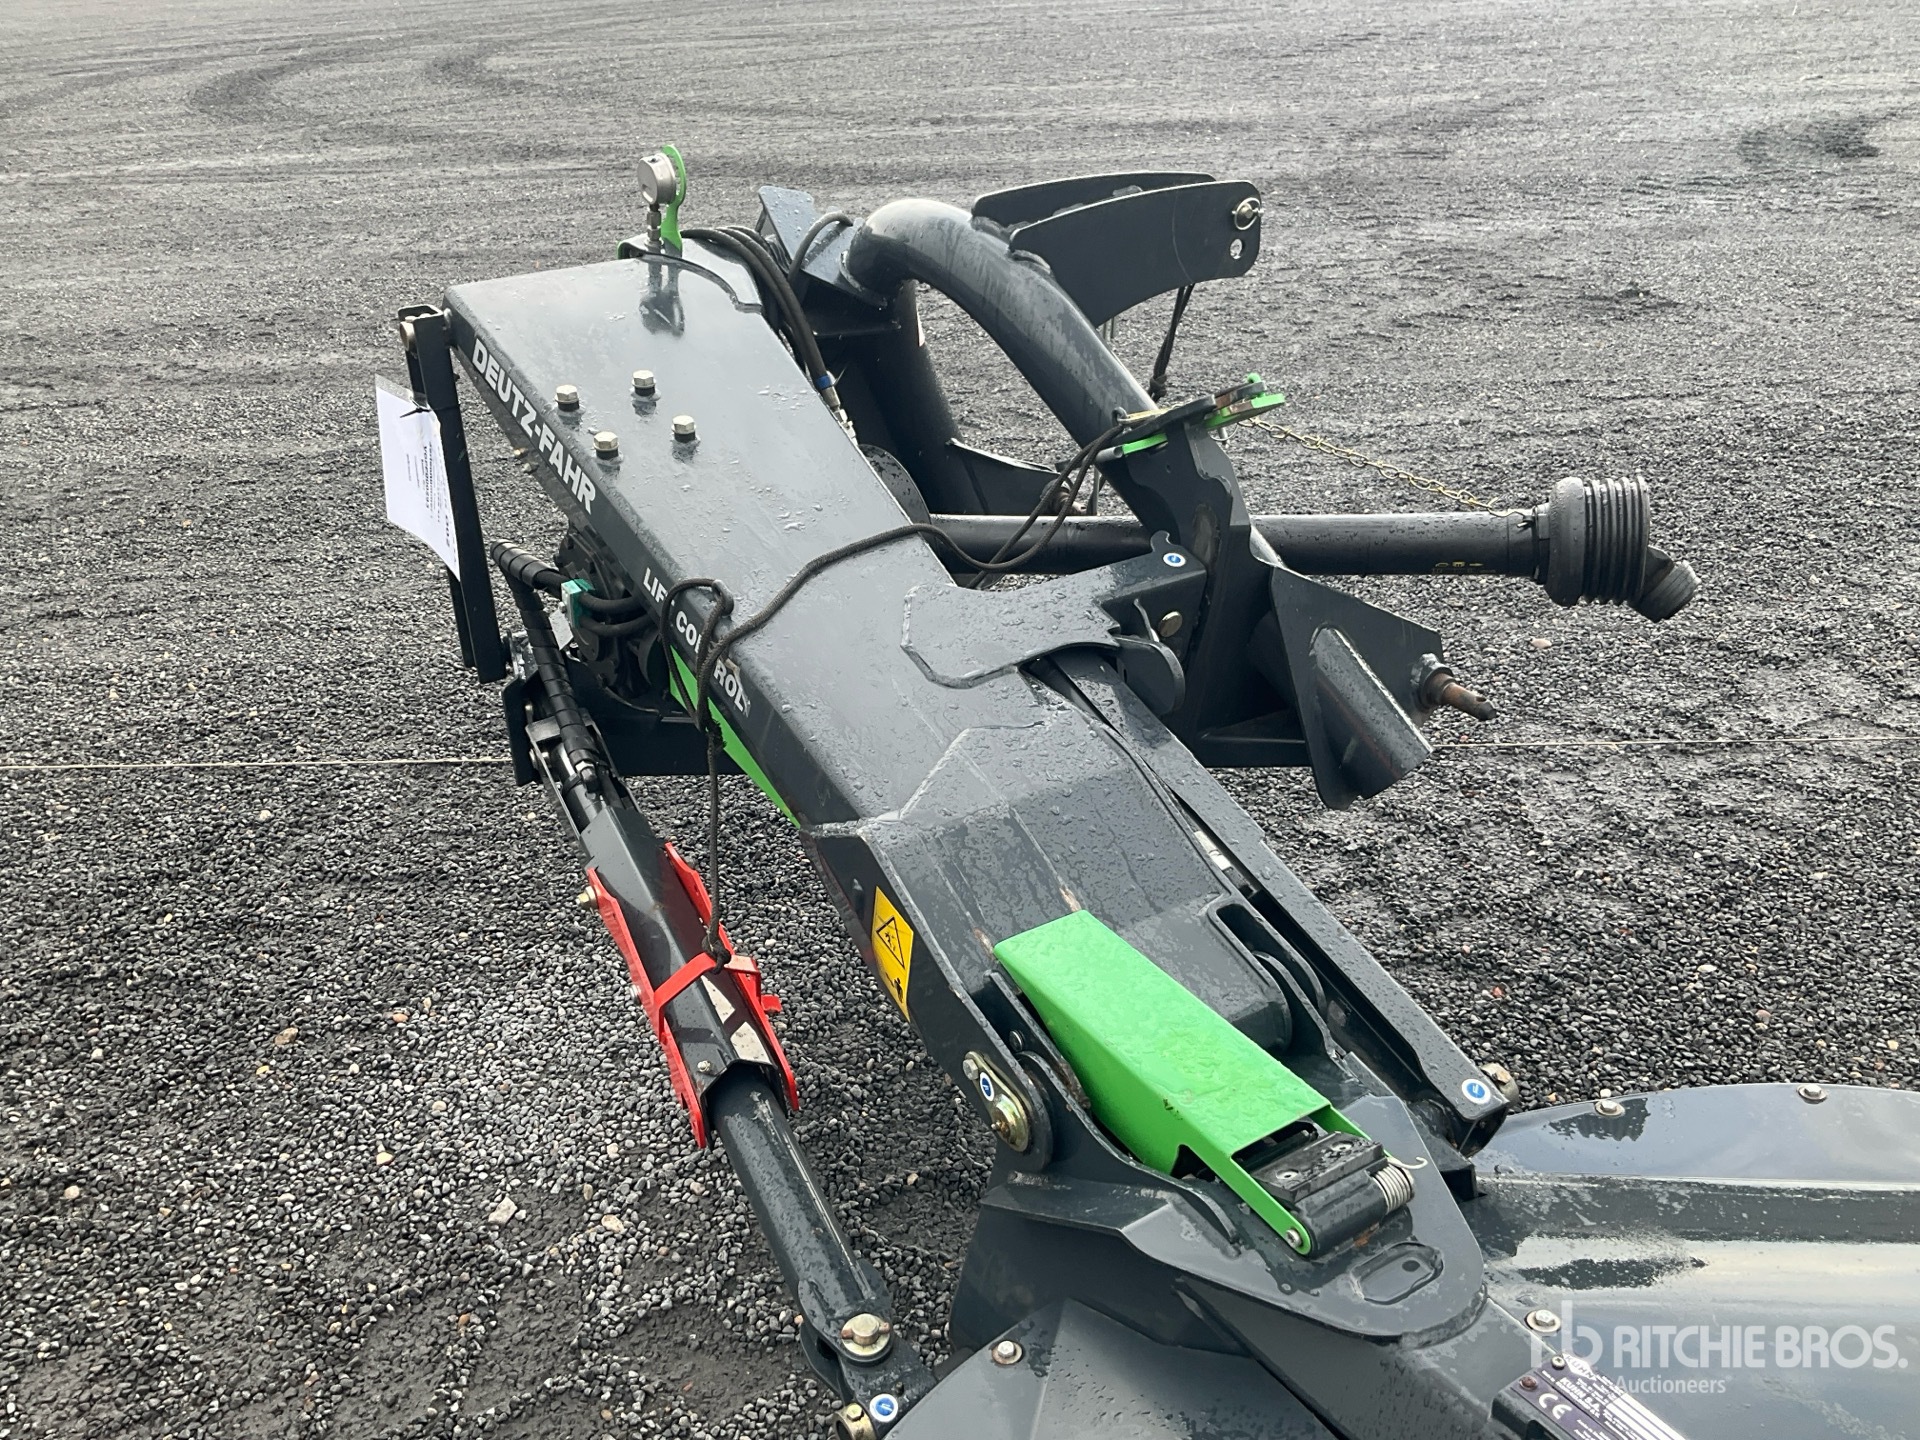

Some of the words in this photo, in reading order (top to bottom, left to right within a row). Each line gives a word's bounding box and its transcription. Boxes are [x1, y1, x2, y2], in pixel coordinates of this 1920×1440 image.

[472, 338, 596, 515] DEUTZ-FAHR
[643, 567, 675, 606] LIF
[676, 611, 746, 712] COROL
[1558, 1376, 1587, 1398] KUHN
[1563, 1354, 1594, 1379] KUHN
